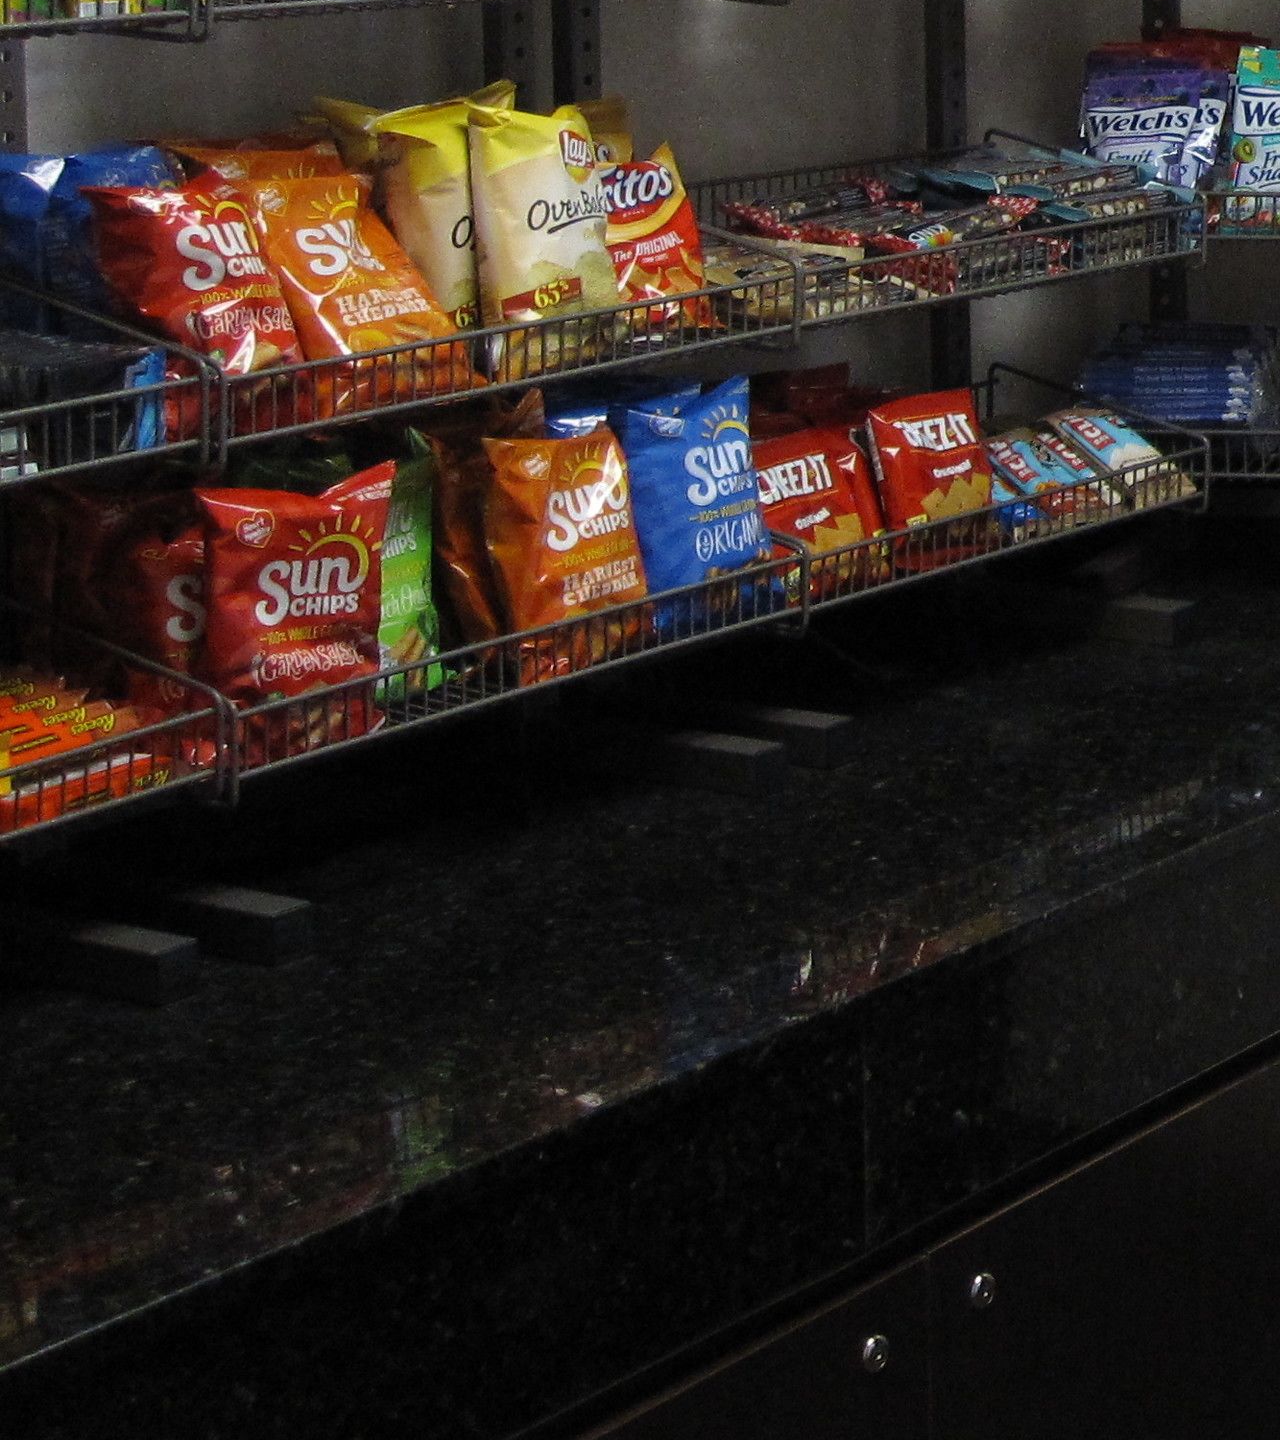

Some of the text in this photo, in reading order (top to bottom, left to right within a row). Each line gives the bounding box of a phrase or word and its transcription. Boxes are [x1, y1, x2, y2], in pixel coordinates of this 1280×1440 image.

[1088, 106, 1191, 138] Welch's
[683, 440, 753, 507] Sun
[578, 509, 630, 540] CHIPS
[695, 512, 766, 563] ORIGIN
[381, 531, 418, 560] HIPS
[255, 556, 369, 627] Sun
[289, 592, 360, 617] CHIPS
